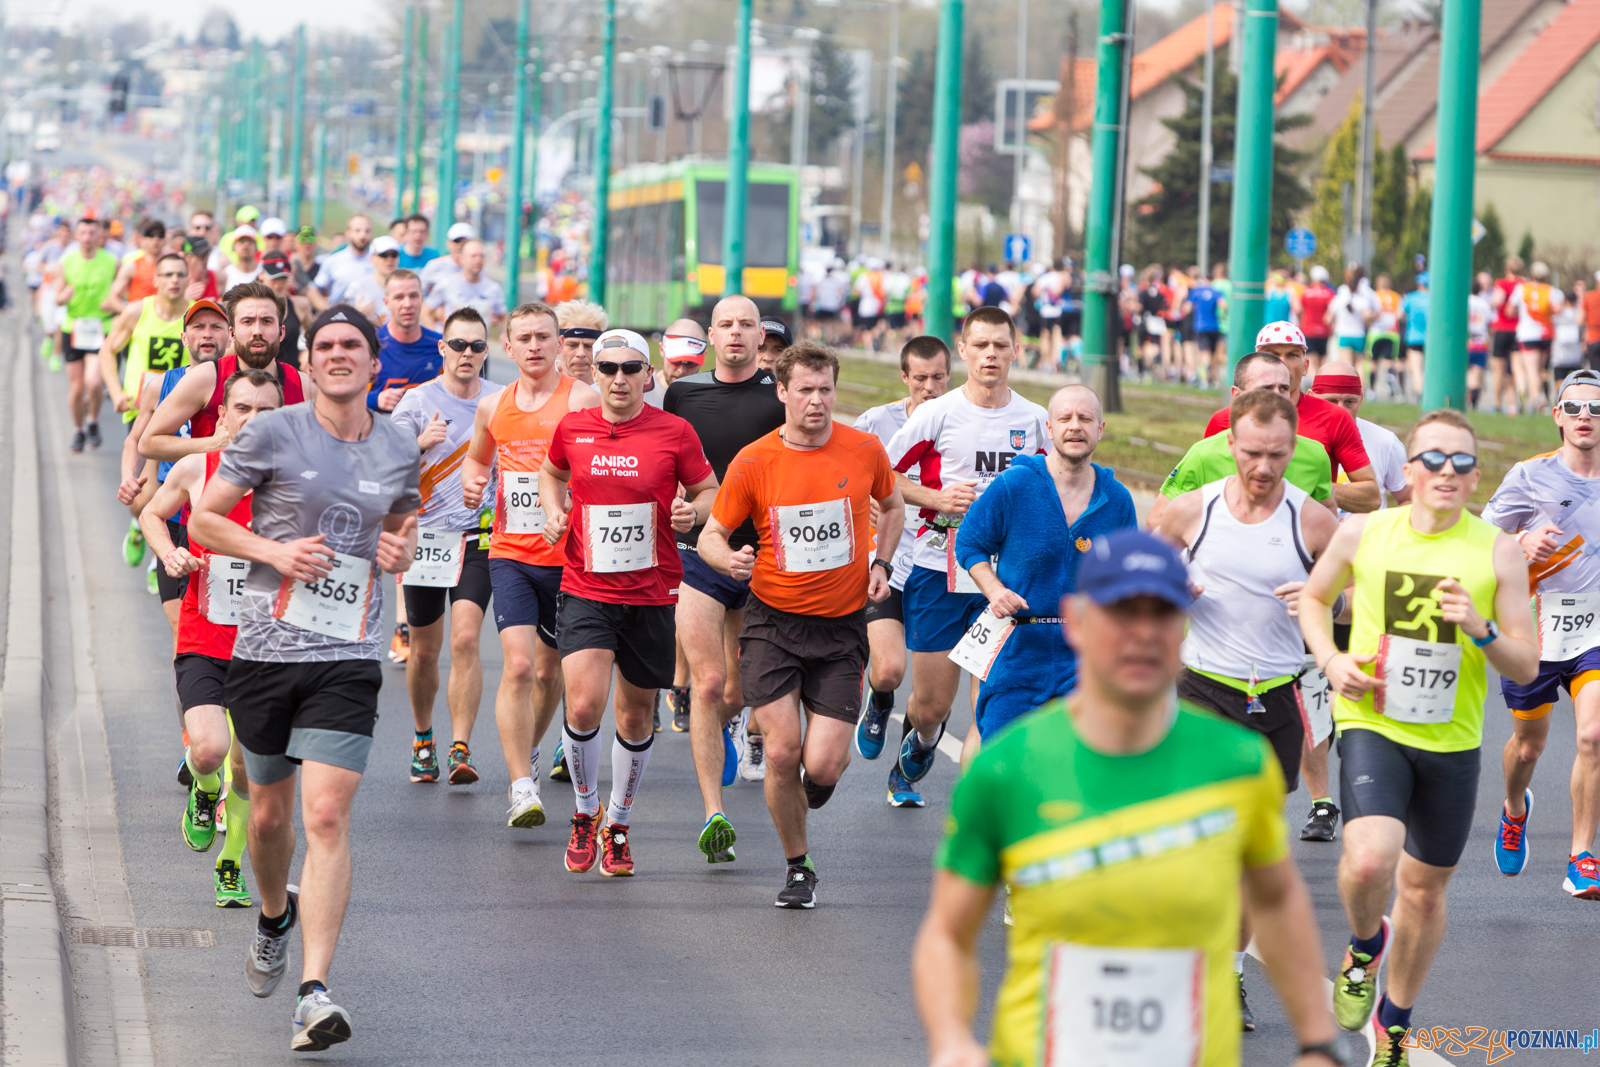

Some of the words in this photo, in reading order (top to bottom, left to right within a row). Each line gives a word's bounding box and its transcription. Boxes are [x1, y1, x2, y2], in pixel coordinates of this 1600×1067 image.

[591, 454, 638, 468] ANIRO
[591, 467, 609, 476] Run
[610, 468, 639, 477] Team
[599, 525, 645, 543] 7673
[789, 522, 841, 543] 9068
[414, 546, 451, 562] 8156
[804, 544, 829, 552] Krzysztof
[304, 578, 360, 604] 4563
[1551, 612, 1595, 632] 7599
[1401, 666, 1457, 690] 5179
[1092, 996, 1164, 1035] 180
